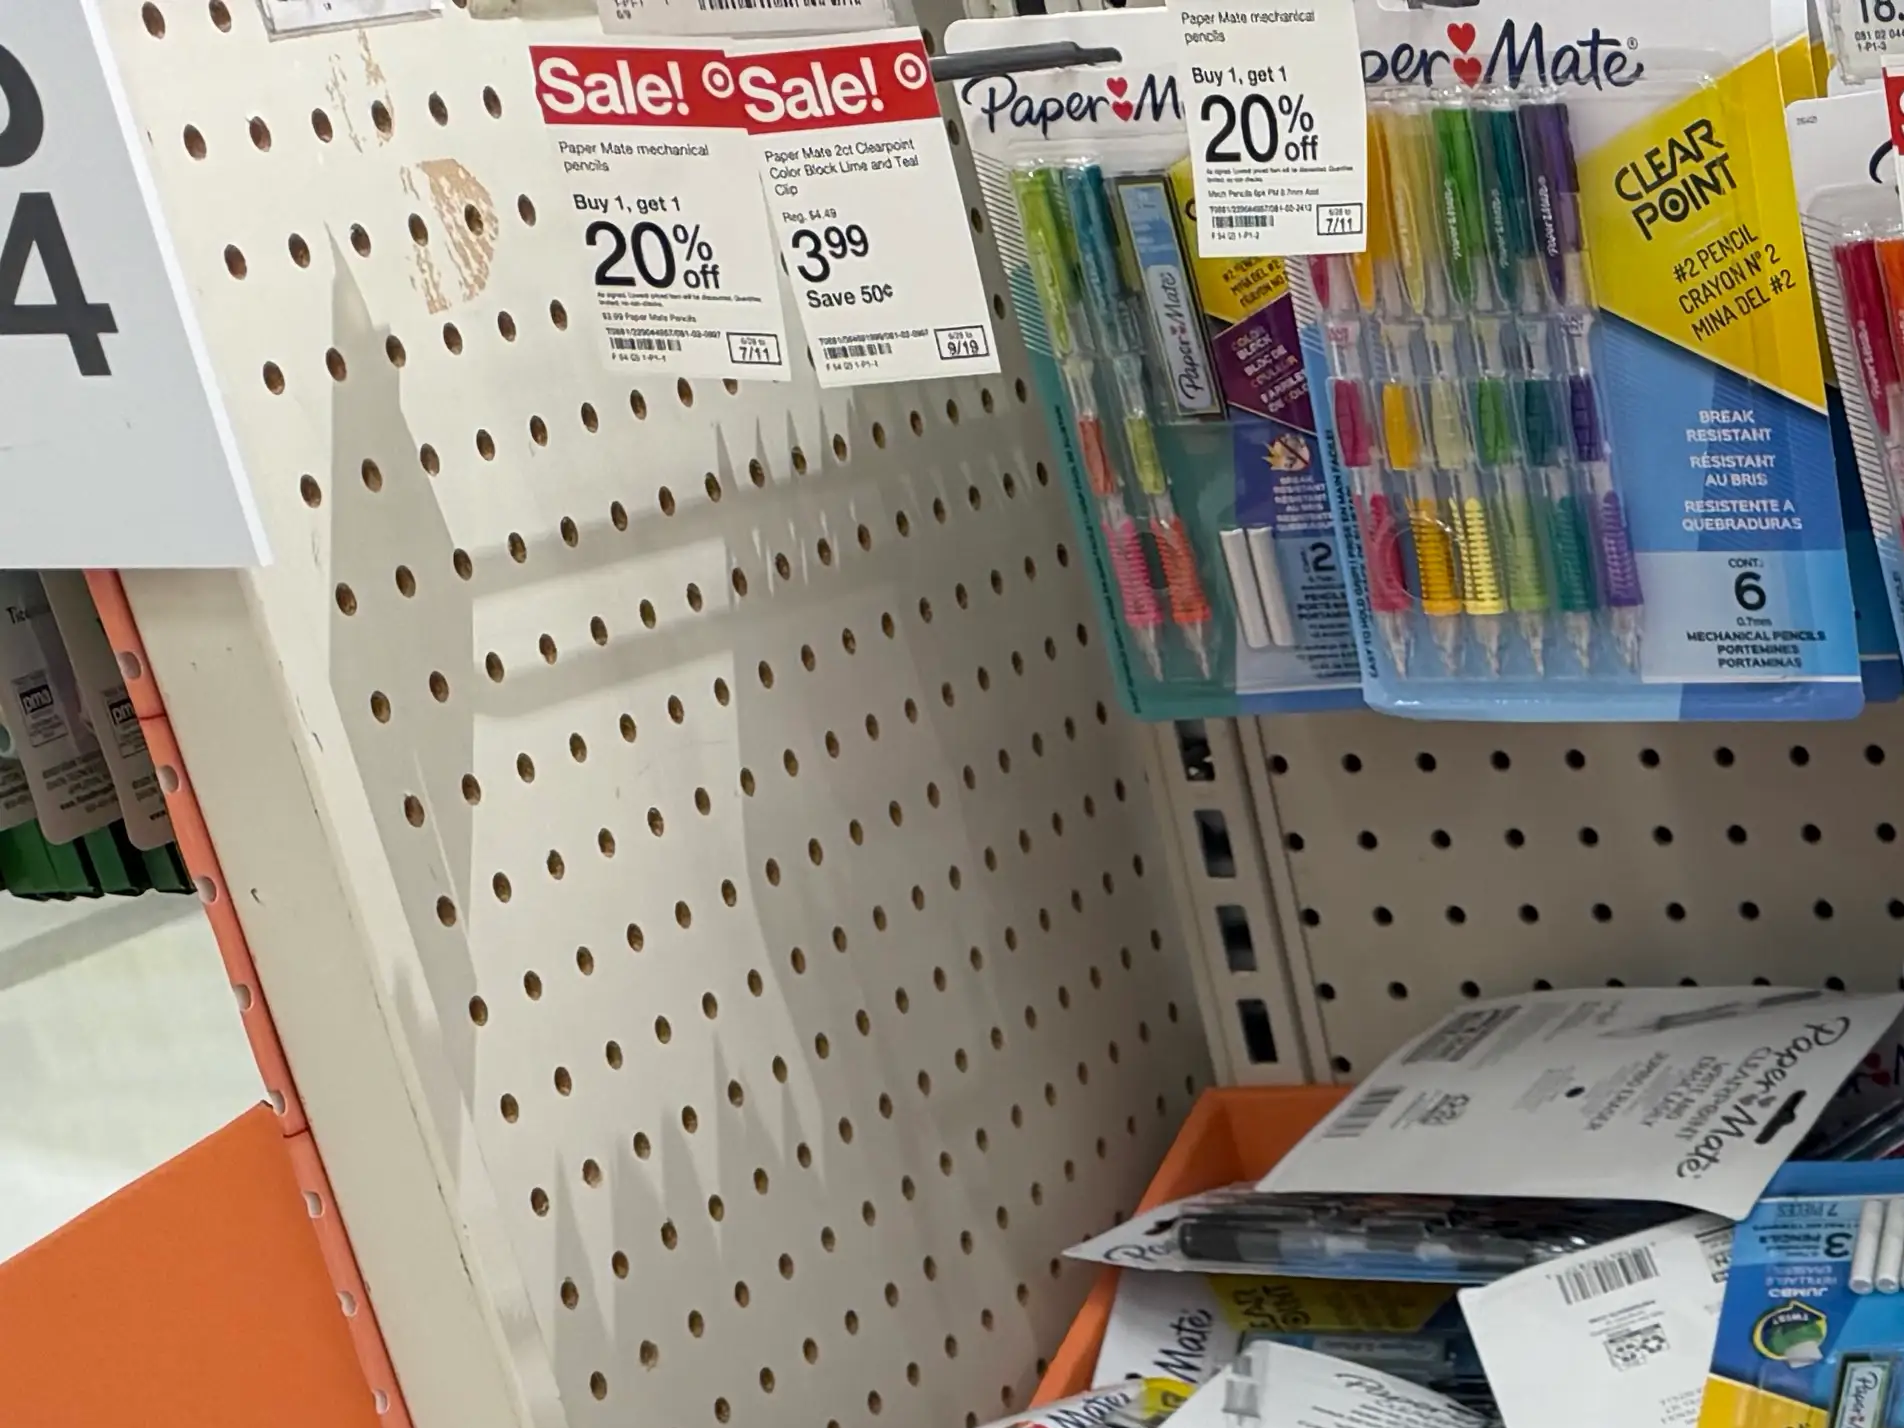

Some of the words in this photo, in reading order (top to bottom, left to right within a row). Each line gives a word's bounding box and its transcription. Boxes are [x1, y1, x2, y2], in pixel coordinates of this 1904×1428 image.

[541, 57, 690, 117] Sale!
[739, 57, 885, 122] Sale!
[558, 141, 598, 158] Paper
[599, 141, 634, 155] Mate
[636, 143, 710, 157] mechanical
[764, 150, 800, 164] Paper
[801, 146, 833, 160] Mate
[834, 143, 855, 157] 2ct
[855, 138, 915, 155] Clearpoint
[1615, 118, 1727, 201] CLEAR
[563, 158, 610, 174] pencils
[572, 193, 609, 214] Buy
[636, 196, 669, 216] get
[671, 195, 681, 212] 1
[1631, 154, 1737, 238] POINT
[586, 222, 715, 289] 20%
[684, 263, 721, 290] off
[806, 288, 855, 309] Save
[860, 283, 894, 304] 50¢
[738, 346, 772, 363] 7/11
[946, 340, 981, 357] 9/19
[1698, 409, 1755, 425] BREAK
[1686, 426, 1773, 443] RESISTANT
[1734, 571, 1767, 612] 6
